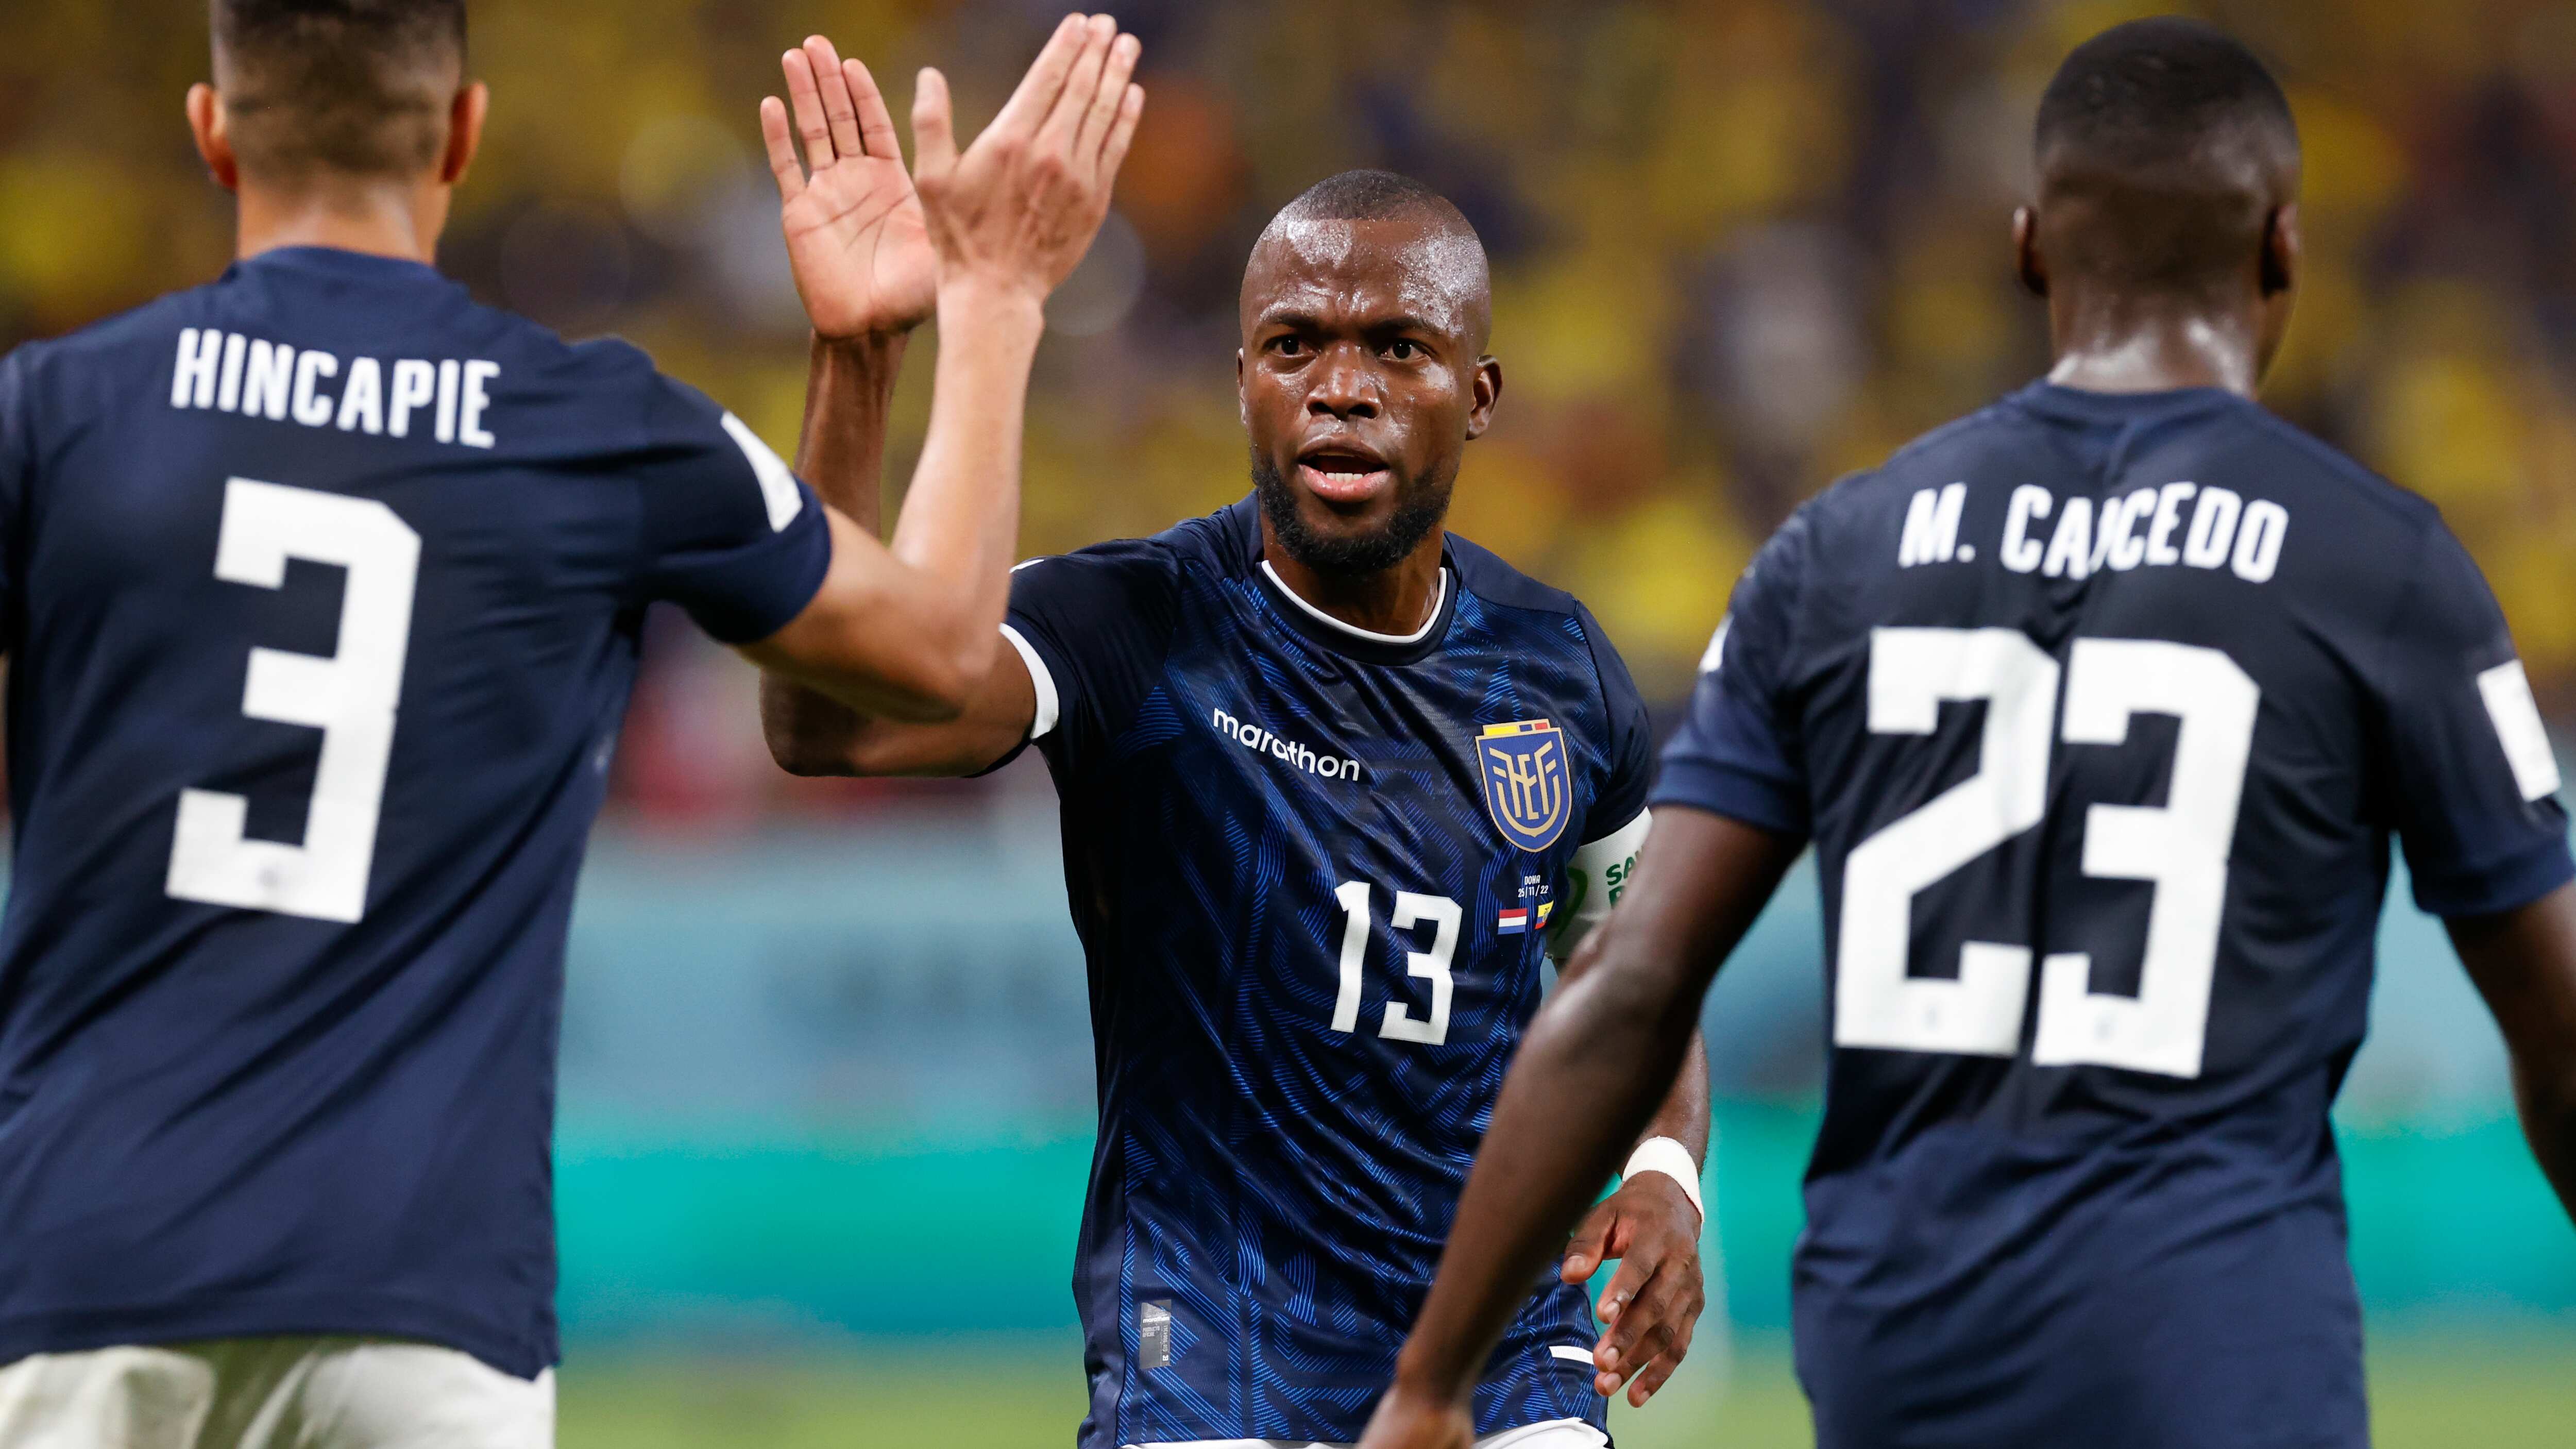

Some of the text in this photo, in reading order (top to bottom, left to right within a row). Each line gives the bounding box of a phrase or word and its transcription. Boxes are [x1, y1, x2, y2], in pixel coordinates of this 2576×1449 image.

[170, 327, 501, 449] HINCAPIE
[1898, 481, 1976, 568] M.
[164, 475, 423, 925] 3
[1213, 707, 1360, 782] marathon
[1524, 874, 1541, 885] DOHA
[1833, 625, 2262, 1080] 23
[1330, 880, 1463, 1046] 13
